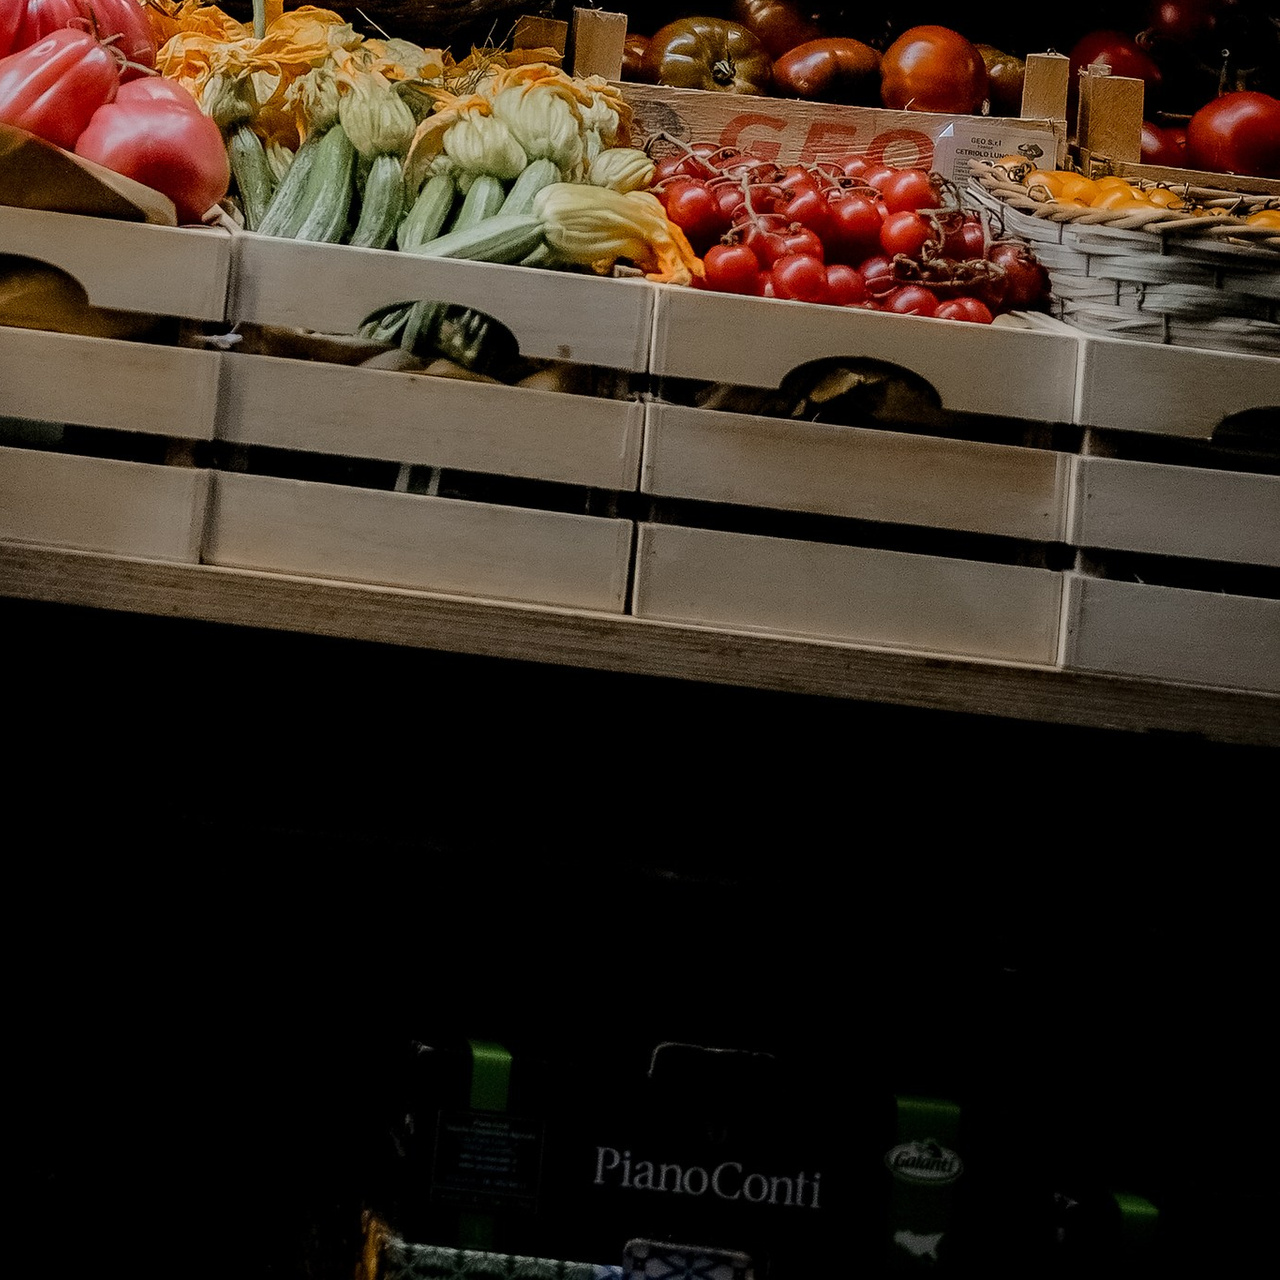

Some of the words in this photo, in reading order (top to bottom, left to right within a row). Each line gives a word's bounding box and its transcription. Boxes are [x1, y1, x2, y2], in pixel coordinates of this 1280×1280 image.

[723, 113, 936, 173] GEO
[955, 148, 988, 156] CETRIOLO
[593, 1146, 823, 1209] PianoConti
